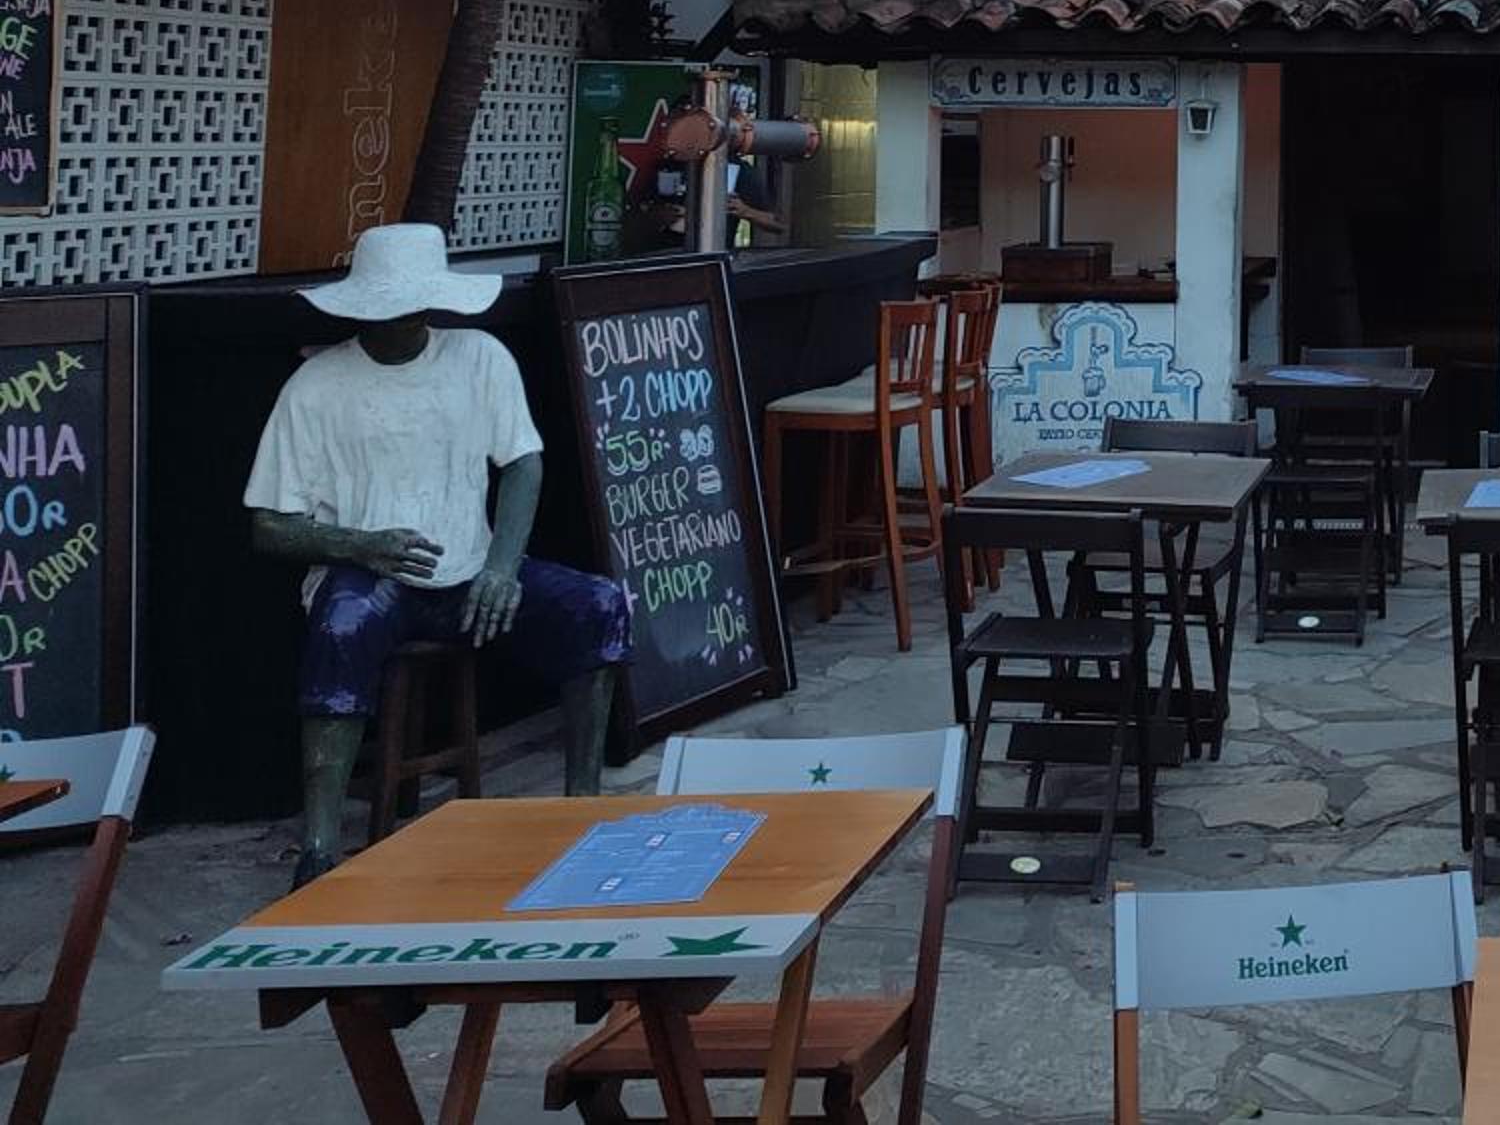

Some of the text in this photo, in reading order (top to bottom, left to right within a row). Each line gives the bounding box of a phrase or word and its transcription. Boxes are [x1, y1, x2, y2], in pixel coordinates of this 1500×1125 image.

[967, 64, 1142, 101] Cervejas
[645, 369, 713, 419] CHOPP
[1012, 400, 1174, 424] LA COLONIA
[607, 466, 690, 527] BURGER
[27, 523, 100, 602] CHOPP
[643, 560, 713, 613] CHOPP
[183, 937, 620, 970] Heineken
[1237, 952, 1349, 980] Heineken
